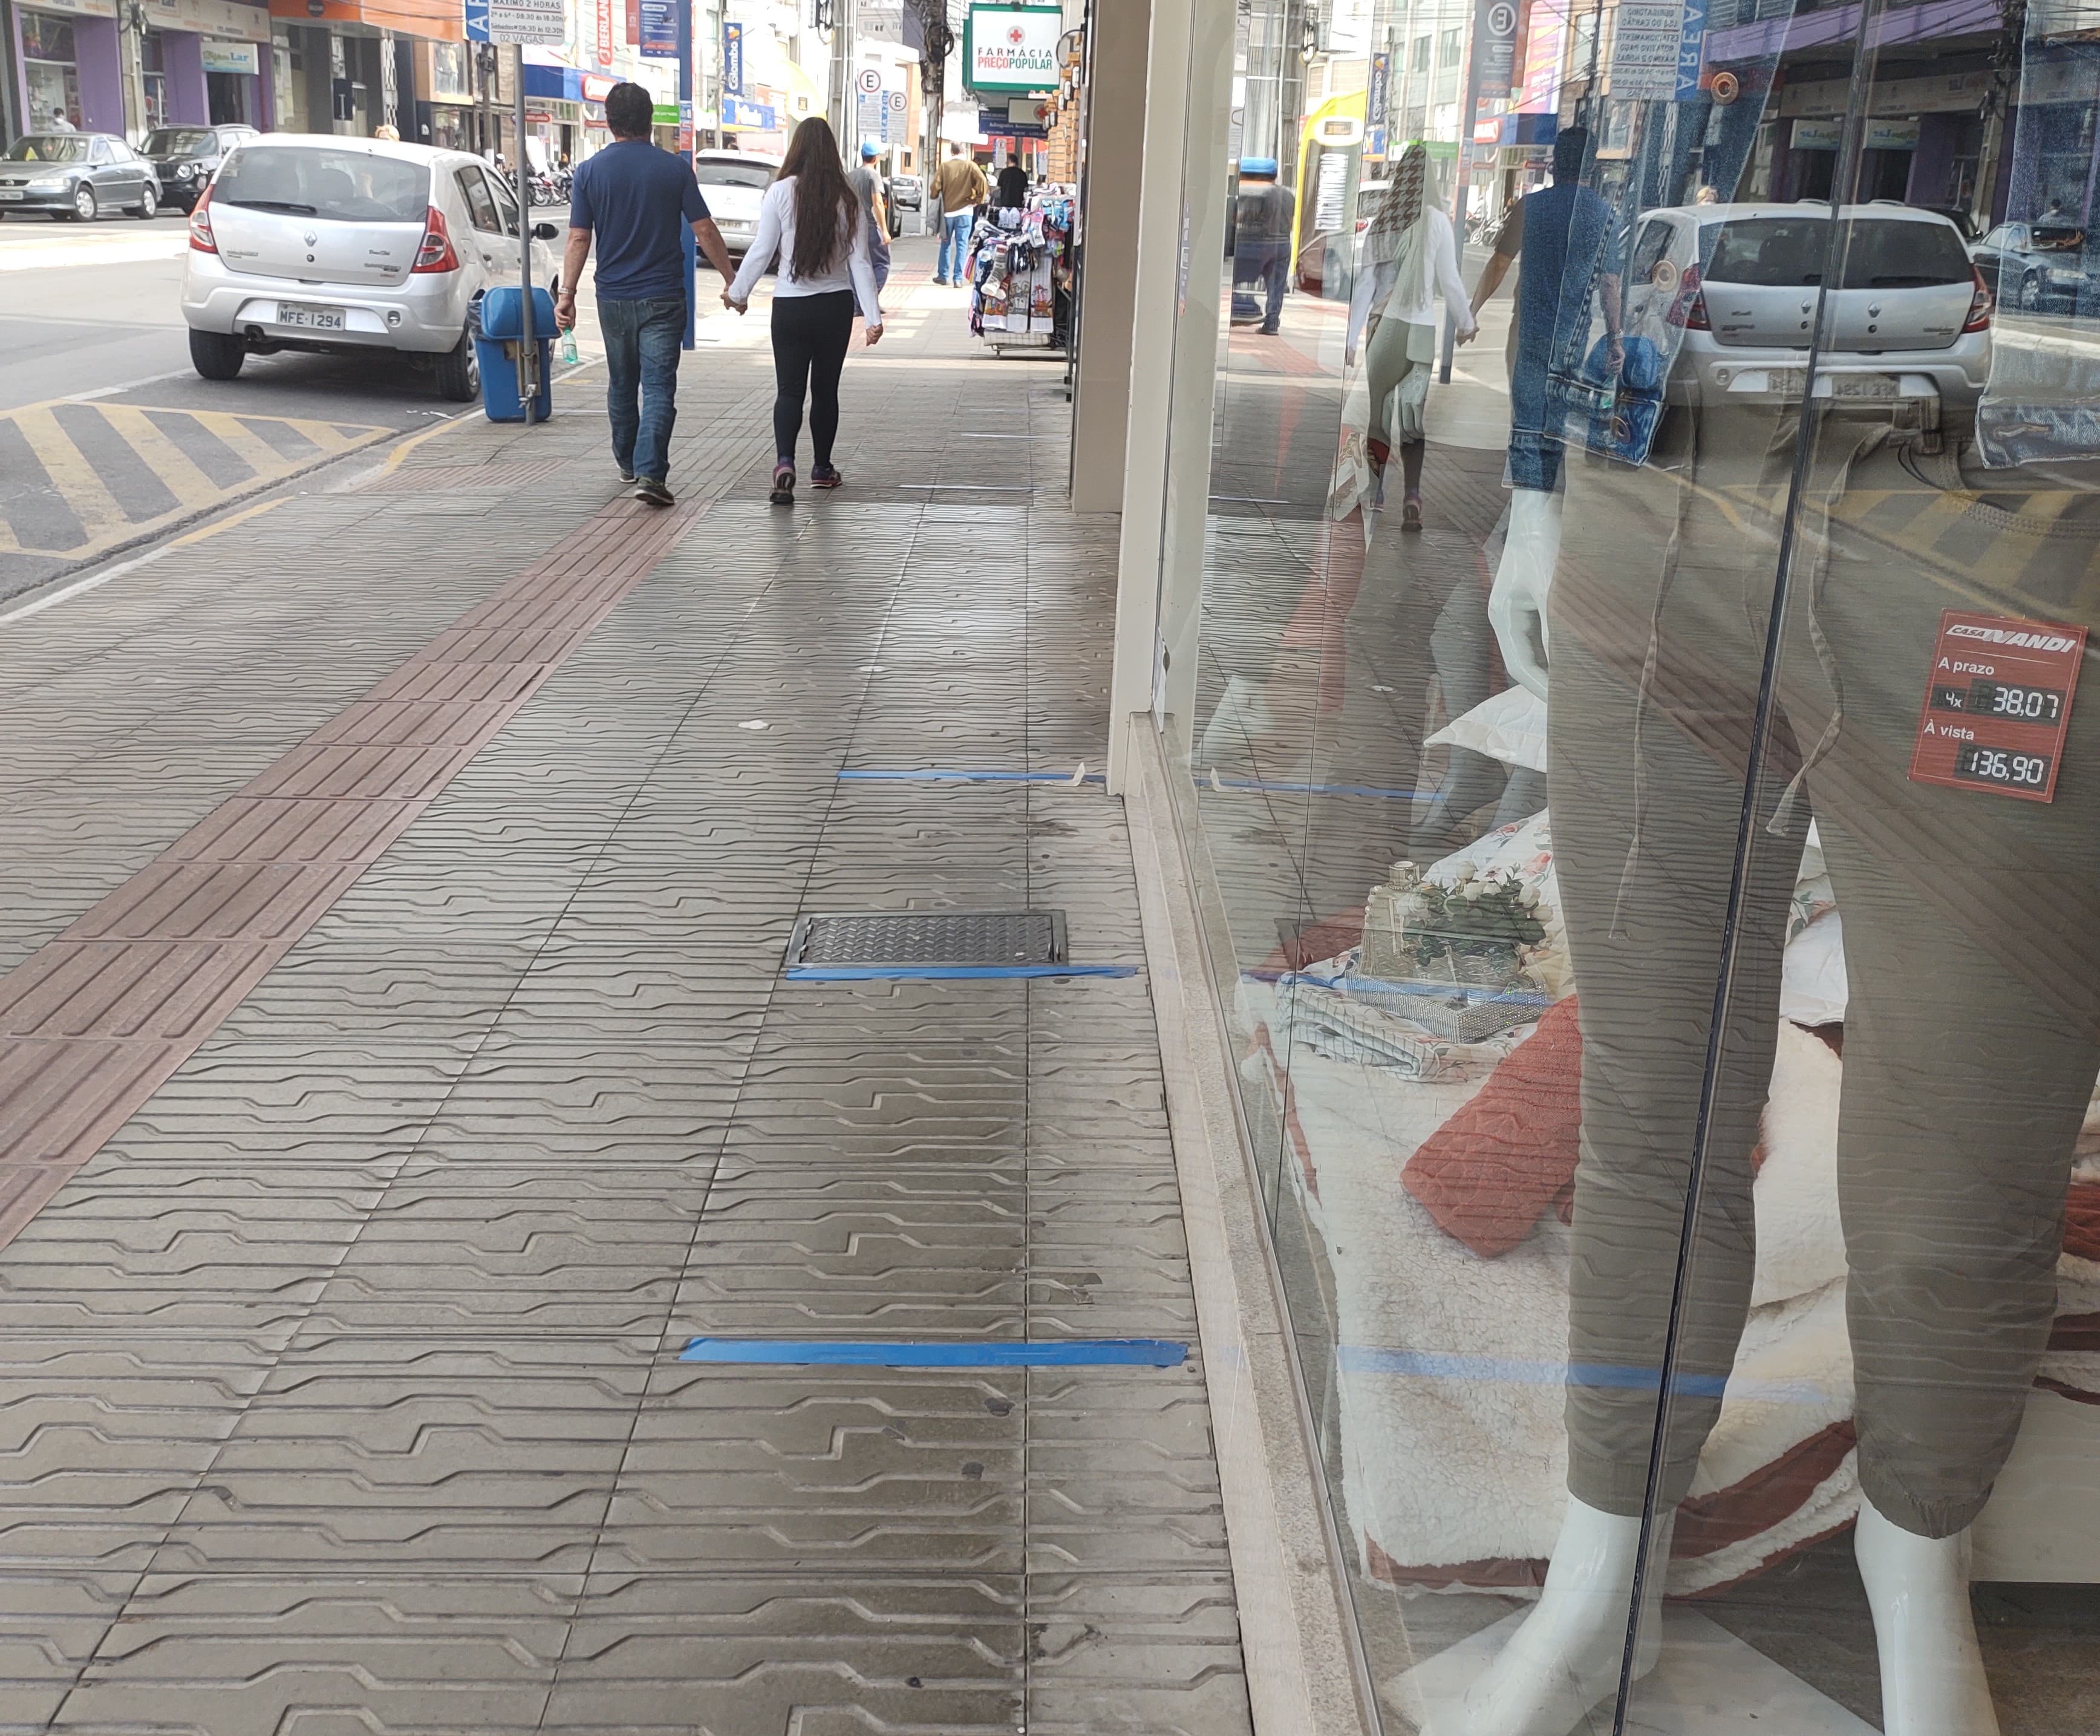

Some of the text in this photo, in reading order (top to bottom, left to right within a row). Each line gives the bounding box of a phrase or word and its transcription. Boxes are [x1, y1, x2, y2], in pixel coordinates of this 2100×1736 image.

[533, 1, 561, 10] HORAS
[512, 34, 545, 44] VAGAS
[978, 46, 1052, 57] FARMÁCIA
[866, 74, 874, 88] E
[895, 96, 901, 107] E
[1937, 657, 1995, 676] A prazo
[1945, 687, 2059, 718] 4x 38,07
[1923, 719, 1974, 740] À vista
[1969, 750, 2044, 784] 136,90
